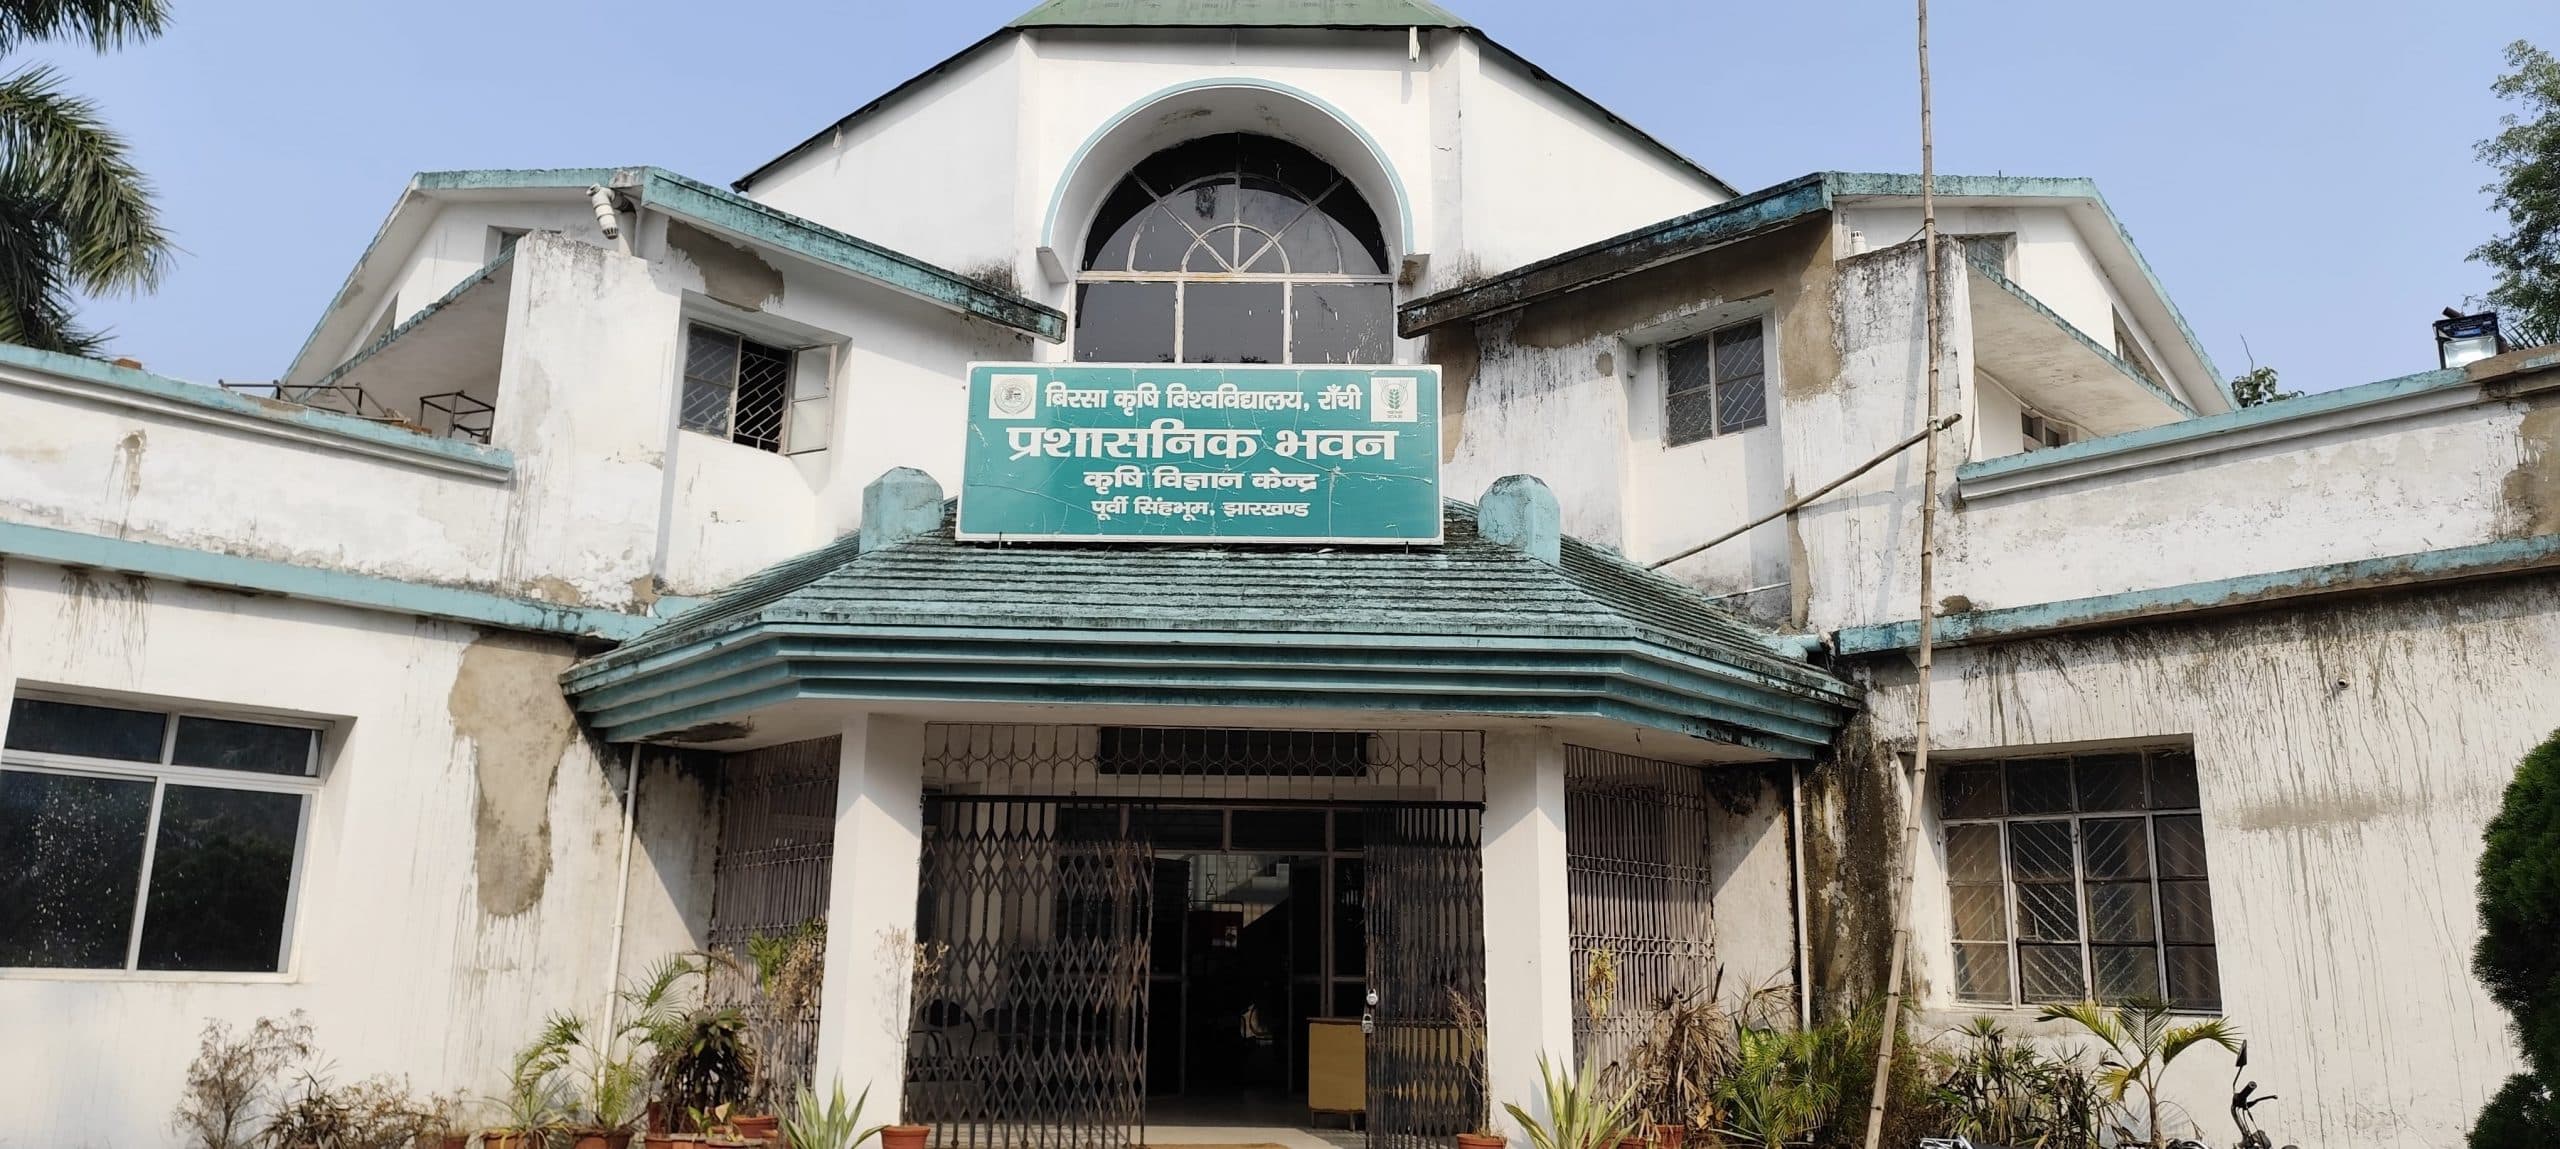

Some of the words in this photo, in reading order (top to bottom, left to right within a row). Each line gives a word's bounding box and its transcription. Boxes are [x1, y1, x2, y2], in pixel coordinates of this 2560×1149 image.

[1044, 381, 1109, 409] बिरसा
[1113, 382, 1161, 416] कृषि
[1165, 382, 1310, 412] विश्वविद्यालय,
[1317, 384, 1363, 411] राँची
[1005, 417, 1262, 461] प्रशासनिक
[1275, 429, 1399, 461] भवन
[1083, 464, 1145, 495] कृषि
[1151, 465, 1245, 491] विज्ञान
[1251, 467, 1320, 493] केन्द्र
[1091, 495, 1129, 520] पूर्वी
[1134, 496, 1215, 521] सिंहभूम,
[1222, 501, 1310, 518] झारखण्ड
